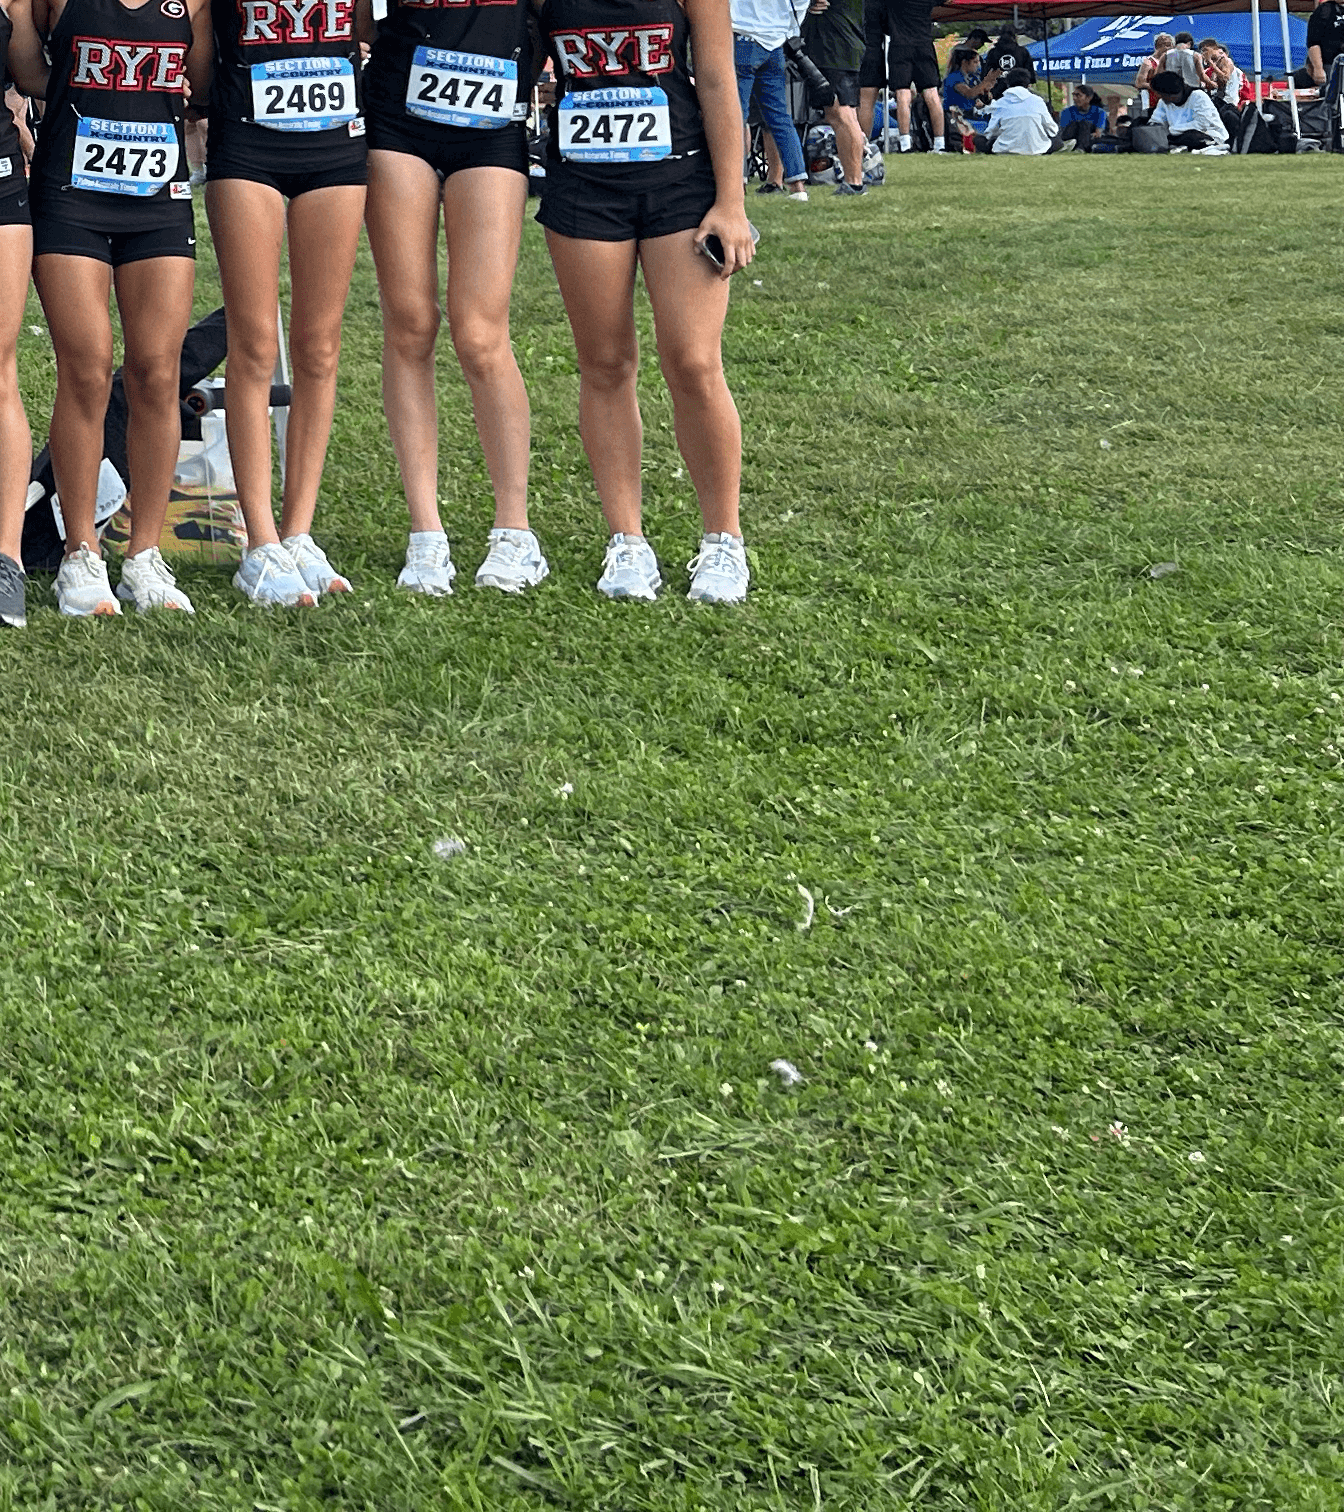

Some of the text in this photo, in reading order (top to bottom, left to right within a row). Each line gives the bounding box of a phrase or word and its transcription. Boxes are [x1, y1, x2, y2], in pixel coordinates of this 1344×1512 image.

[550, 23, 674, 77] RYE
[70, 37, 188, 92] RYE
[266, 59, 331, 71] SECTION
[426, 49, 495, 70] SECTION
[266, 69, 342, 78] X-COUNTRY
[426, 61, 506, 77] X-COUNTRY
[265, 82, 345, 114] 2469
[417, 73, 503, 112] 2474
[573, 89, 640, 101] SECTION
[573, 99, 653, 108] X-COUNTRY
[90, 119, 158, 135] SECTION
[570, 113, 658, 144] 2472
[90, 131, 167, 142] X-COUNTRY
[84, 144, 167, 177] 2473
